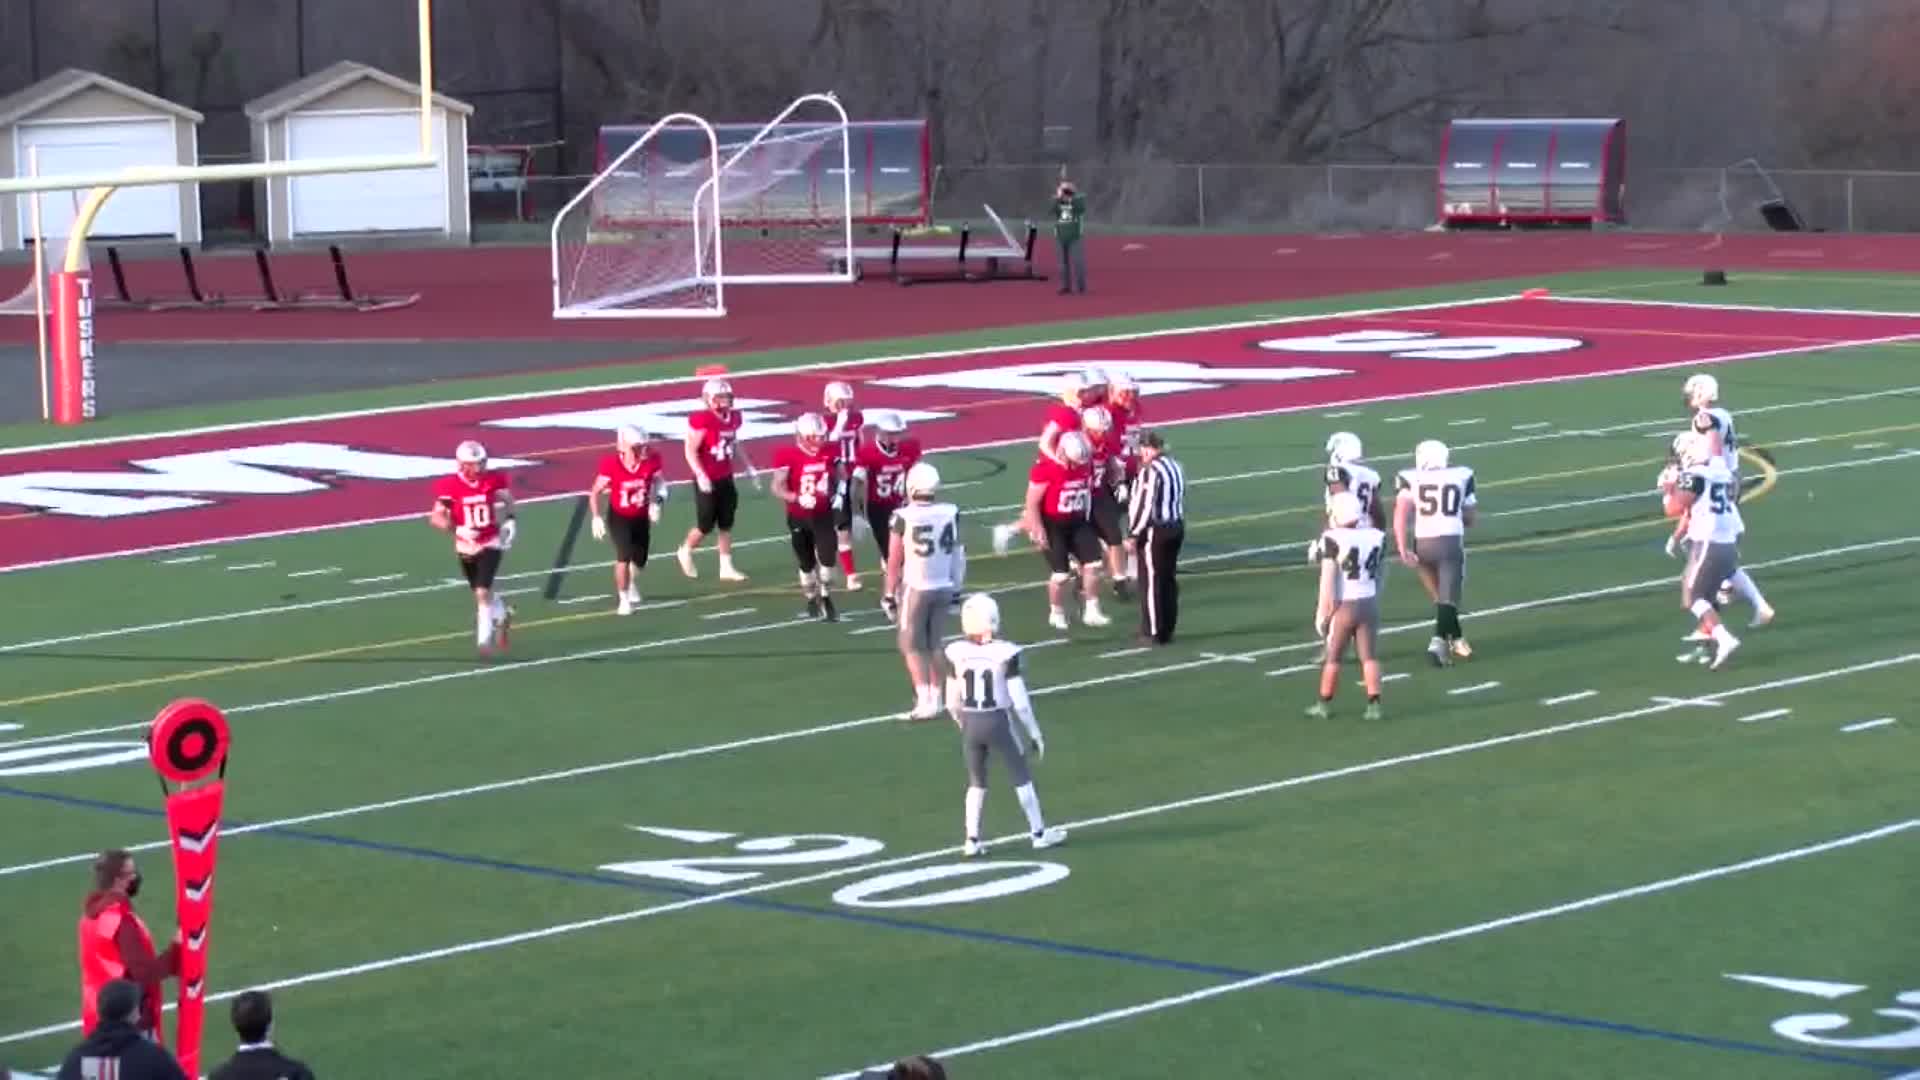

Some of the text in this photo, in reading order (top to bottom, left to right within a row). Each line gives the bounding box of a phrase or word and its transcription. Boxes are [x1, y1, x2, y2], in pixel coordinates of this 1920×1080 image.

[76, 278, 96, 418] TUSKERS
[618, 487, 647, 508] 14
[1417, 483, 1462, 517] 50
[462, 503, 491, 528] 10
[911, 522, 955, 558] 54
[1341, 546, 1381, 581] 44
[962, 668, 998, 709] 11
